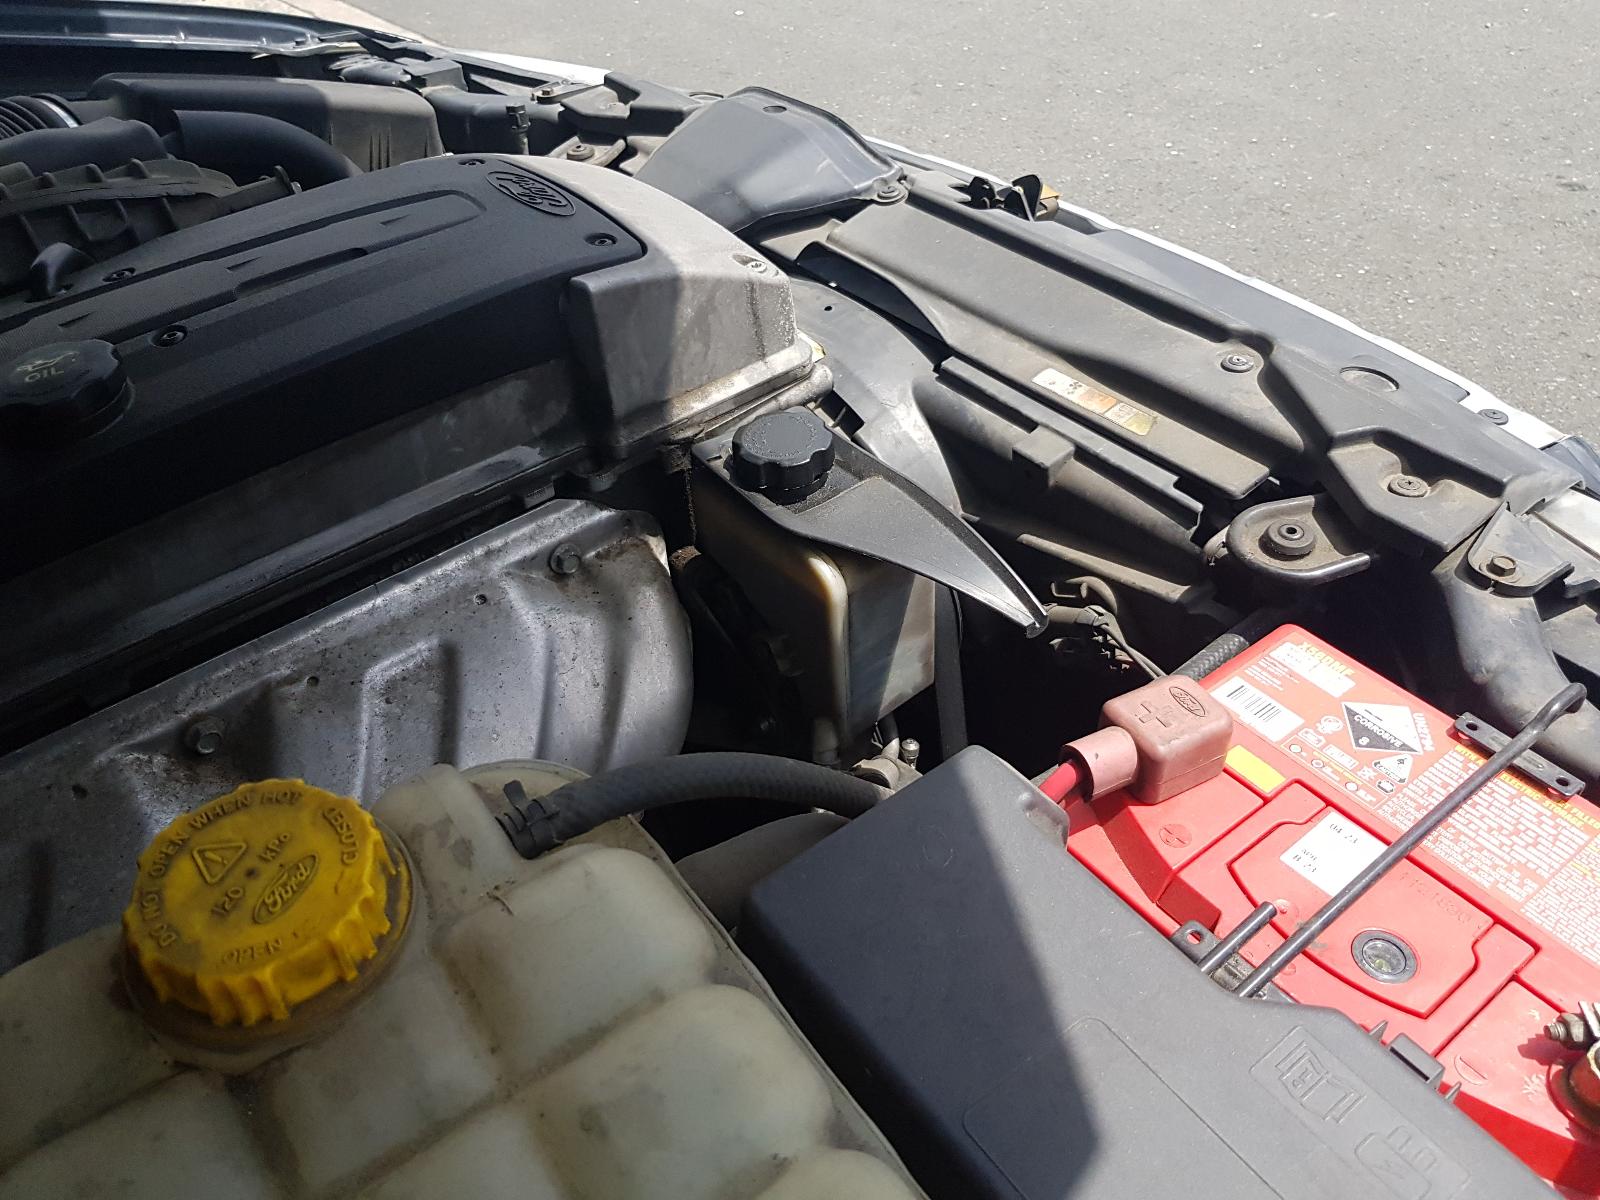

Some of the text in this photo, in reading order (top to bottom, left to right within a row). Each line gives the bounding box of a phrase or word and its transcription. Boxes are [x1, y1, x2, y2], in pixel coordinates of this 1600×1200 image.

[25, 367, 65, 382] OIL
[1354, 714, 1404, 748] CORROSIVE
[1358, 736, 1370, 746] 8
[1500, 772, 1541, 800] ELECTRIC
[188, 795, 251, 829] WHEN
[149, 831, 190, 877] OPEN
[264, 862, 312, 913] Ford
[150, 921, 177, 947] DO
